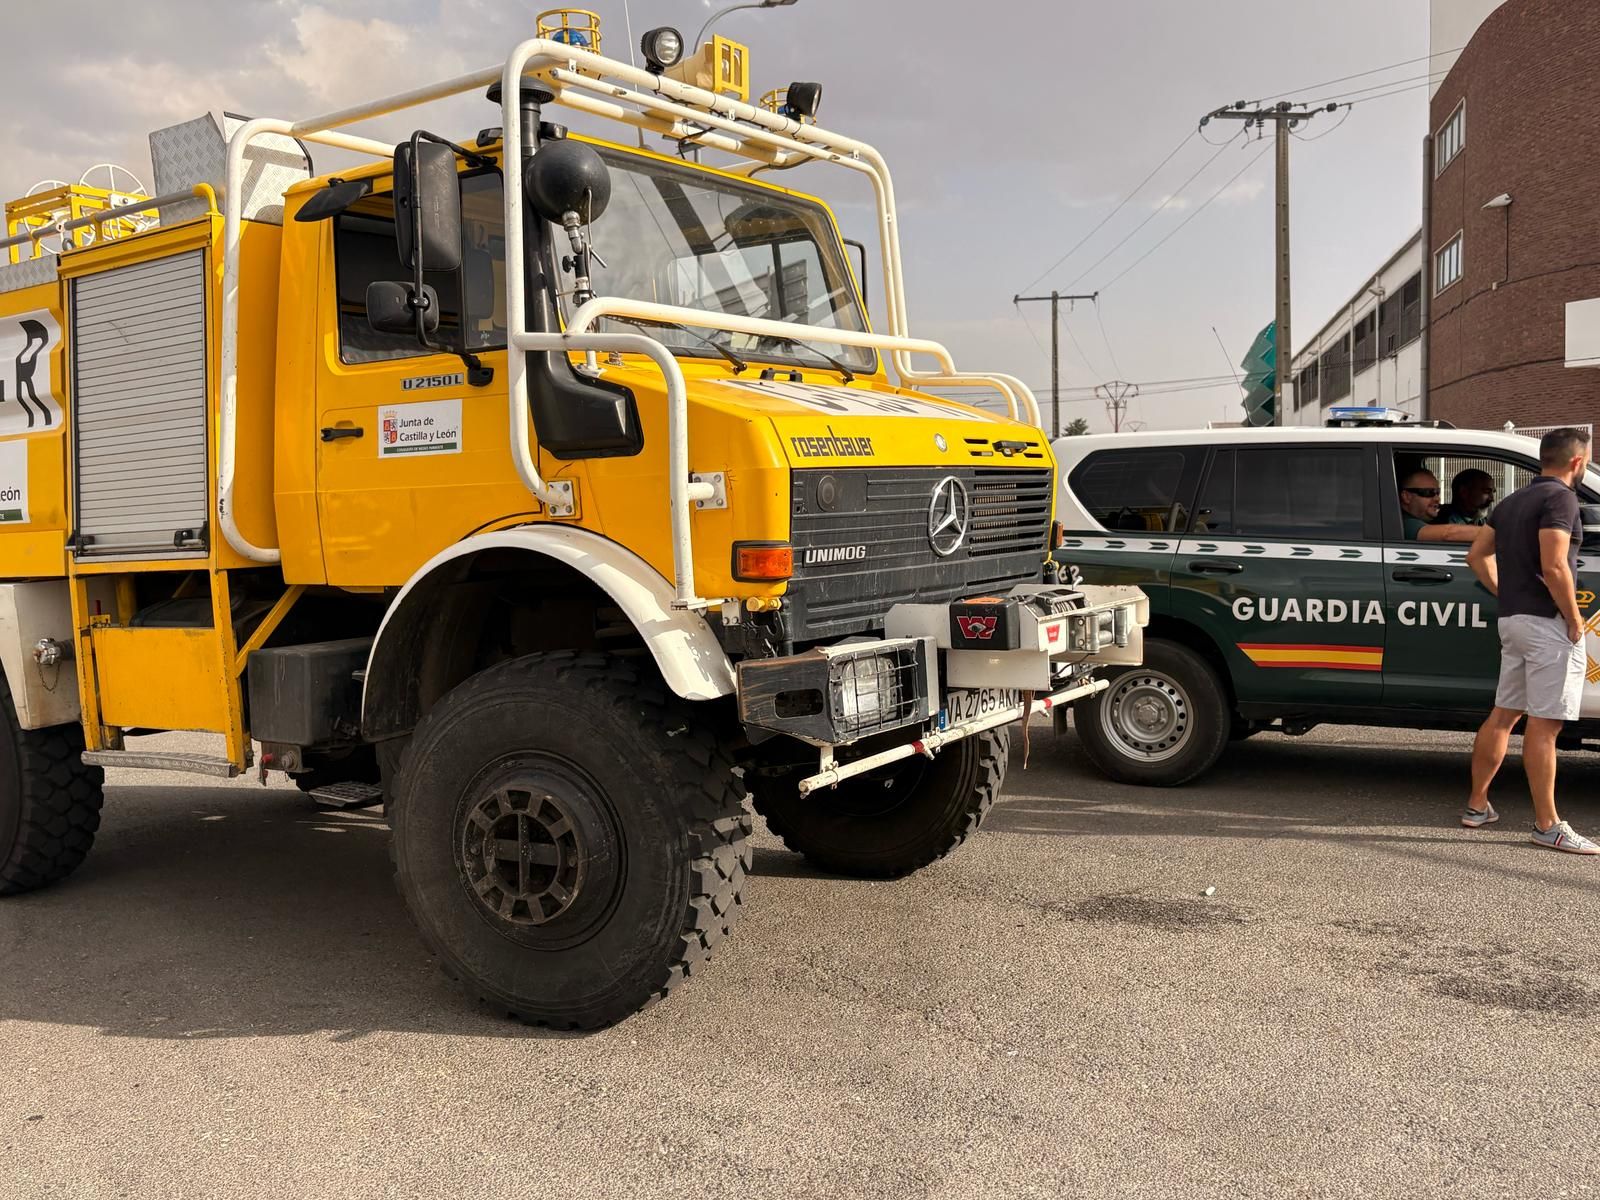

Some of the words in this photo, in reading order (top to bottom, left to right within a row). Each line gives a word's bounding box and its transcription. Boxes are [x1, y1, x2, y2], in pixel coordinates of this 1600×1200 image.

[403, 380, 413, 390] U
[416, 376, 452, 388] 2150
[455, 374, 463, 385] L
[399, 418, 421, 428] Junta
[423, 417, 434, 426] de
[399, 431, 428, 442] Castilla
[429, 433, 434, 442] y
[436, 429, 457, 439] León
[790, 425, 875, 457] rosenbauer
[805, 545, 866, 564] UNIMOG
[1231, 596, 1386, 625] GUARDIA
[1397, 600, 1488, 628] CIVIL
